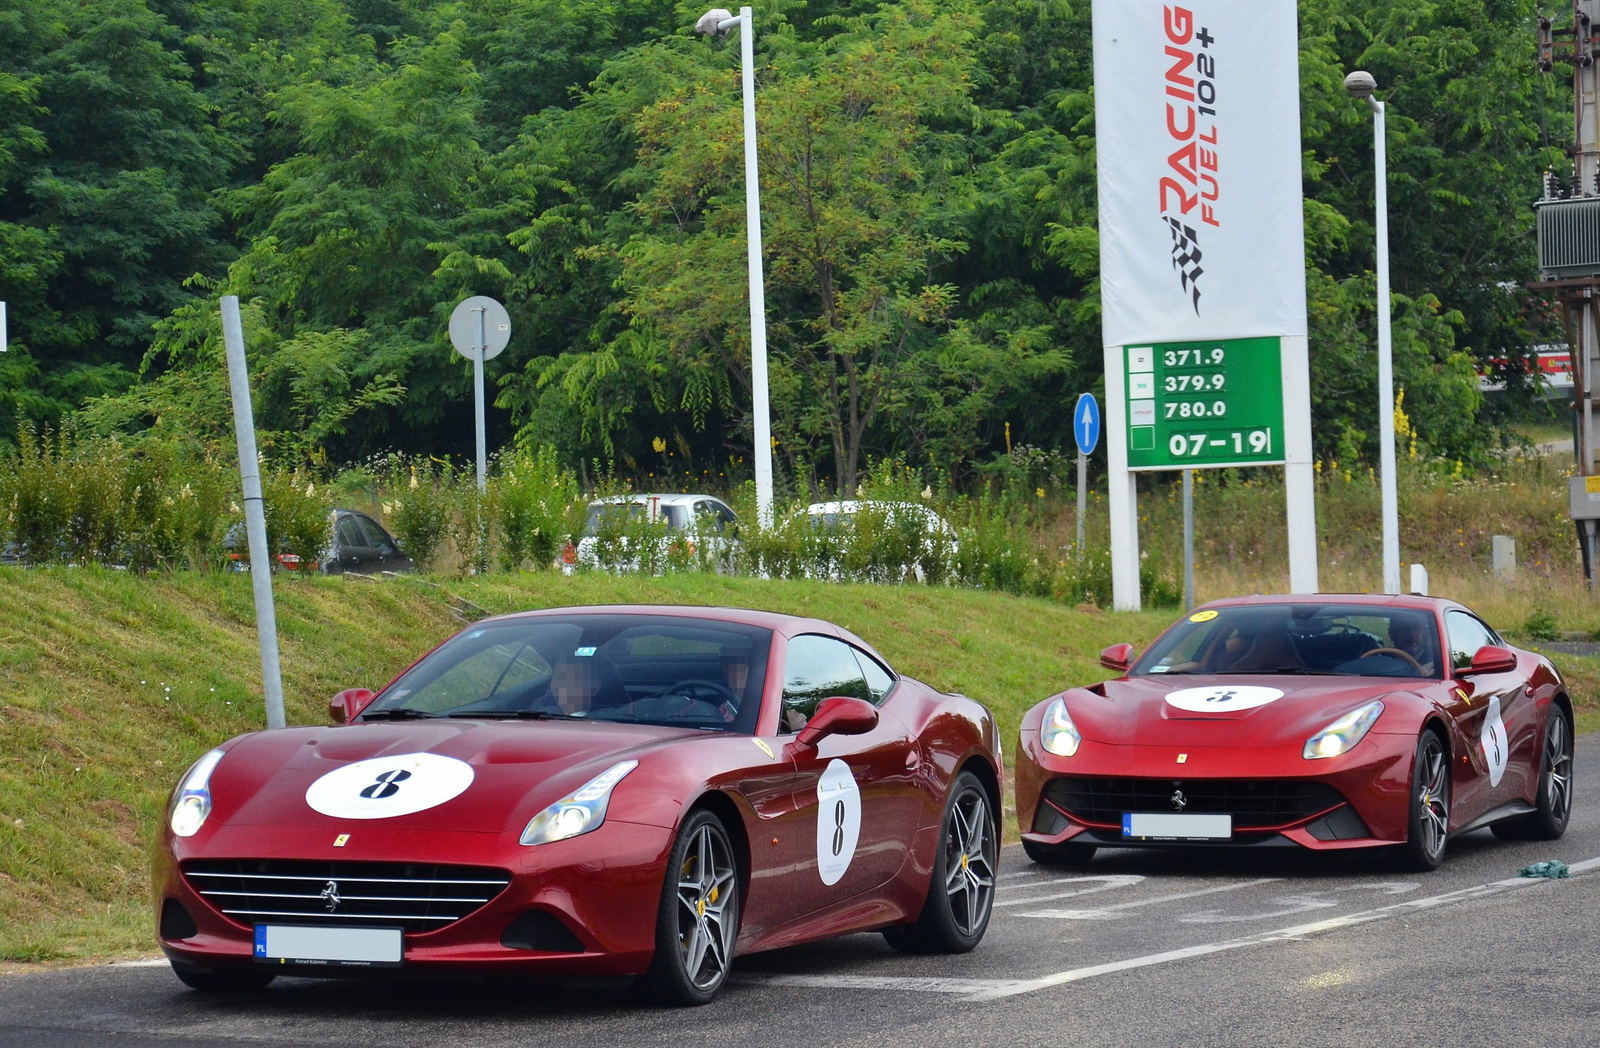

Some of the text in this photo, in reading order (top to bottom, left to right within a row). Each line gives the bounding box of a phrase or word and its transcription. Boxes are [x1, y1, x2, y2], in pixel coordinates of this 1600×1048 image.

[1159, 4, 1198, 215] RACING
[1196, 27, 1220, 227] FUEL 102+
[1164, 348, 1225, 366] 371.9
[1164, 374, 1225, 391] 379.9
[1165, 400, 1226, 418] 780.0
[1490, 725, 1500, 766] 3
[359, 769, 412, 799] 8
[832, 799, 845, 857] 8
[256, 944, 266, 953] PL
